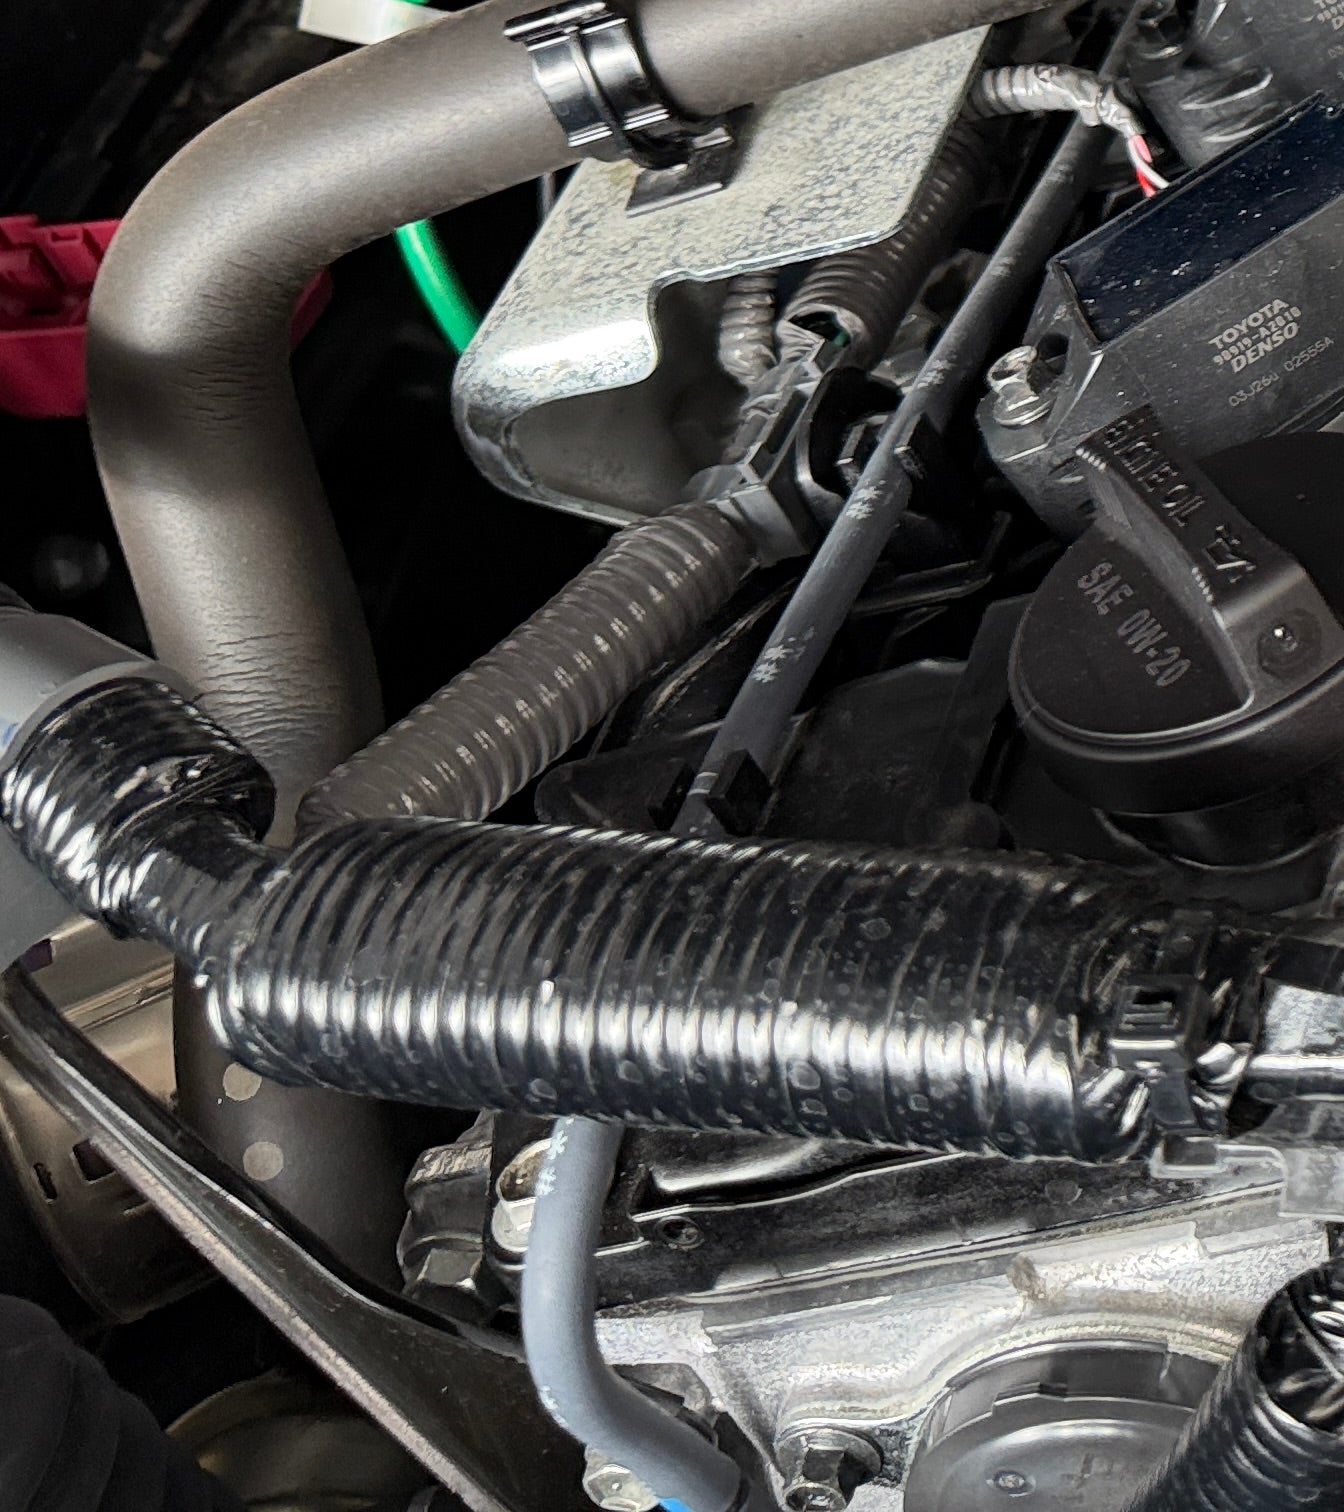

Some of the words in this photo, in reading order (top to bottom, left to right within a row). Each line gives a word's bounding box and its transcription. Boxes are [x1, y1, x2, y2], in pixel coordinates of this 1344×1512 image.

[1208, 298, 1290, 350] TOYOTA
[1230, 321, 1301, 374] DENSO
[1076, 557, 1134, 617] SAE
[1116, 604, 1194, 688] 0W-20
